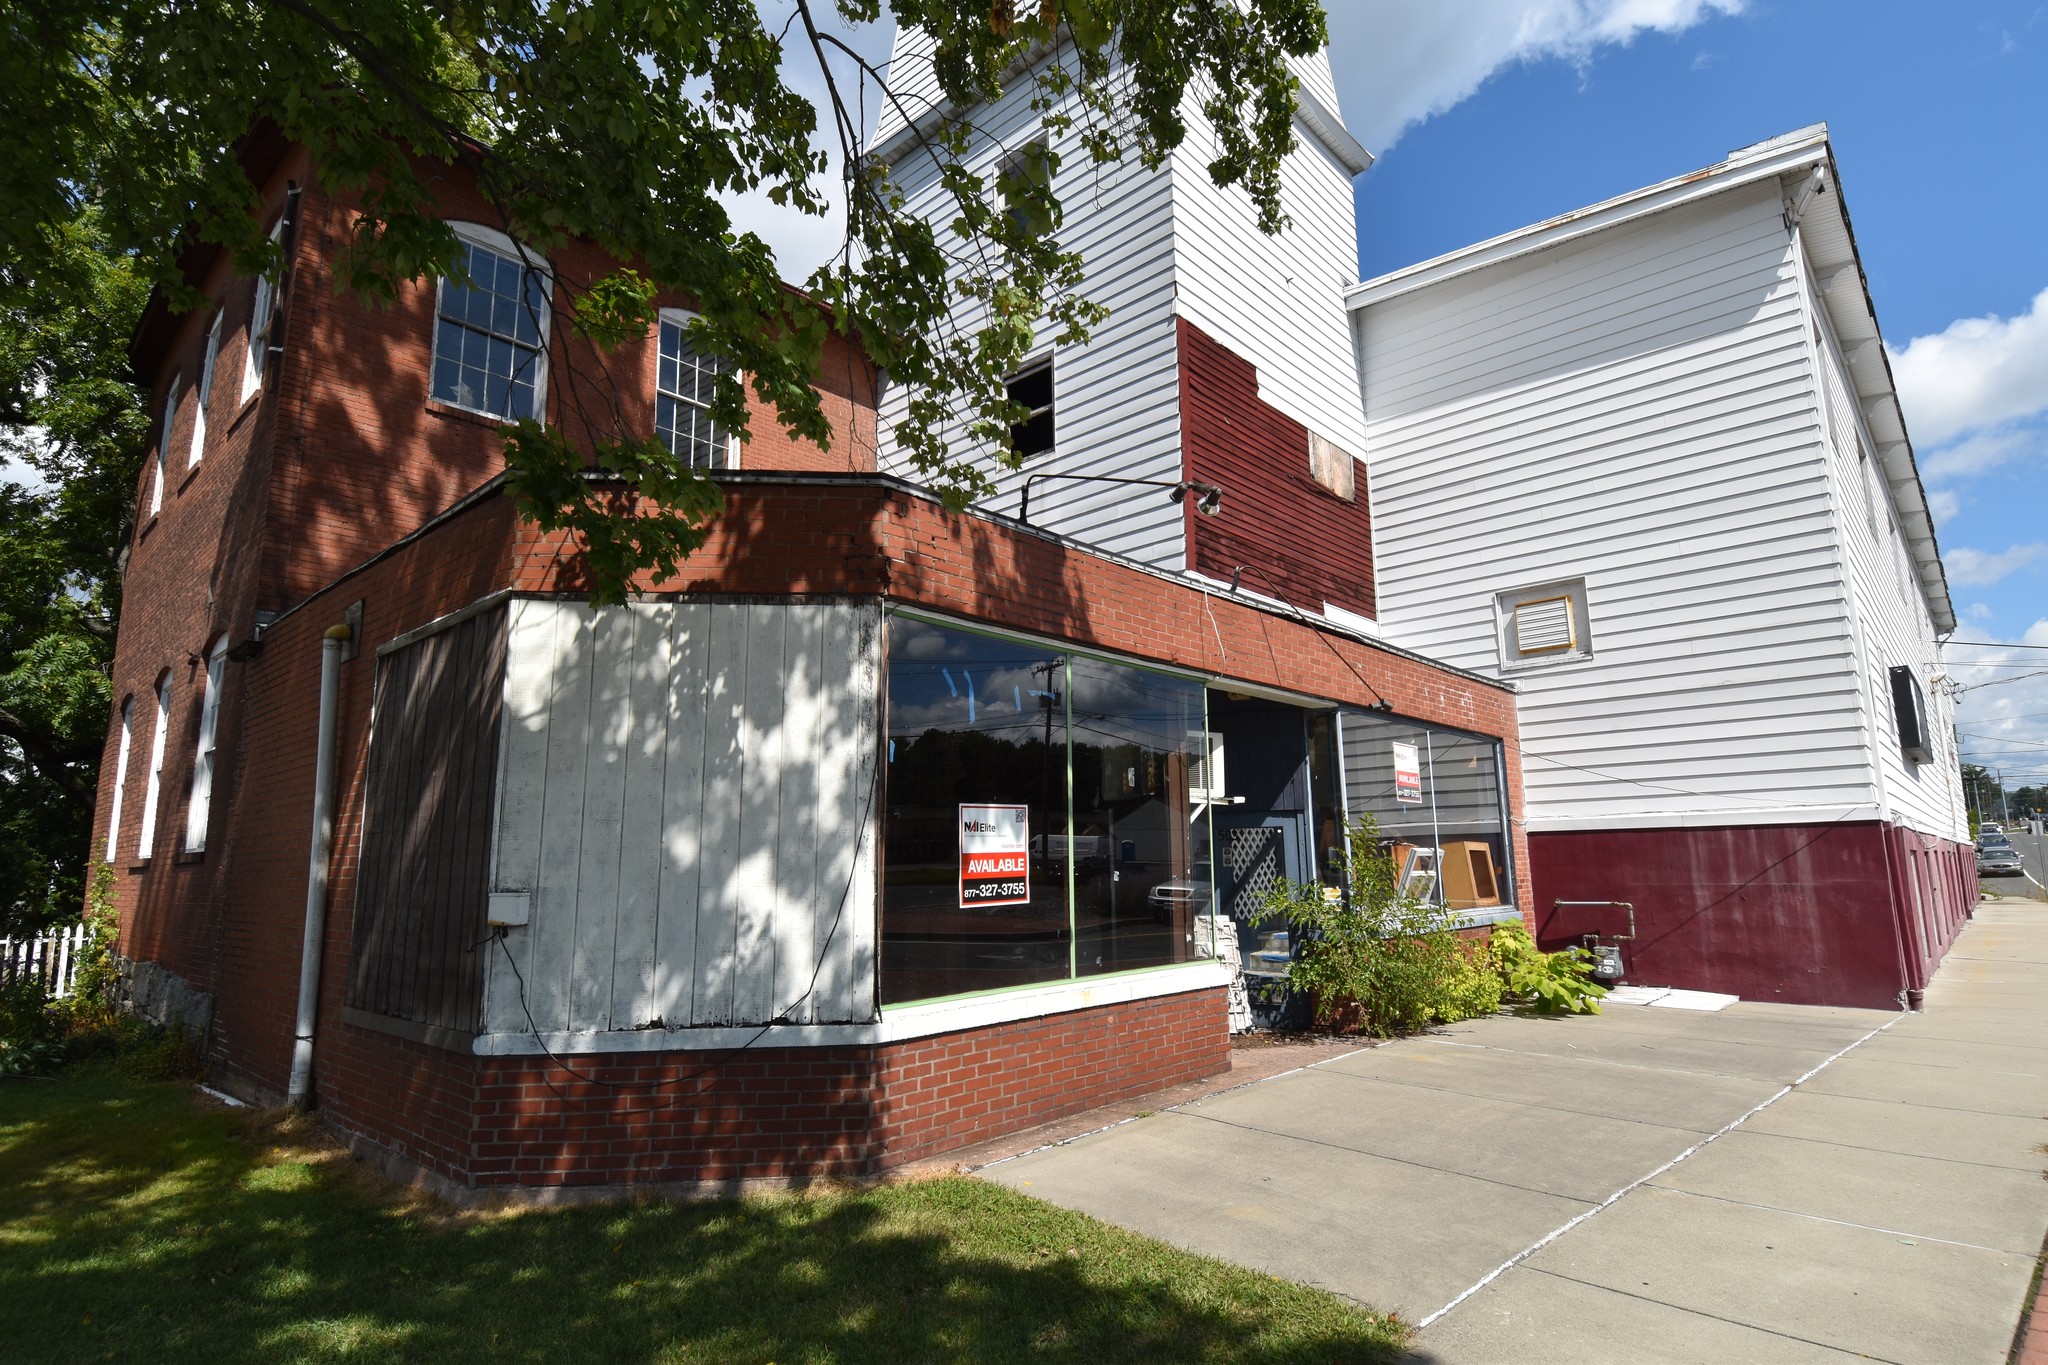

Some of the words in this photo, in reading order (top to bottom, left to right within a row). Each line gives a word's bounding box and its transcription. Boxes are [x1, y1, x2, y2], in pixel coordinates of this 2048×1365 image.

[964, 820, 979, 832] NAI
[980, 823, 996, 832] Elite
[968, 858, 1025, 873] AVAILABLE
[964, 882, 1025, 898] 877-327-3755
